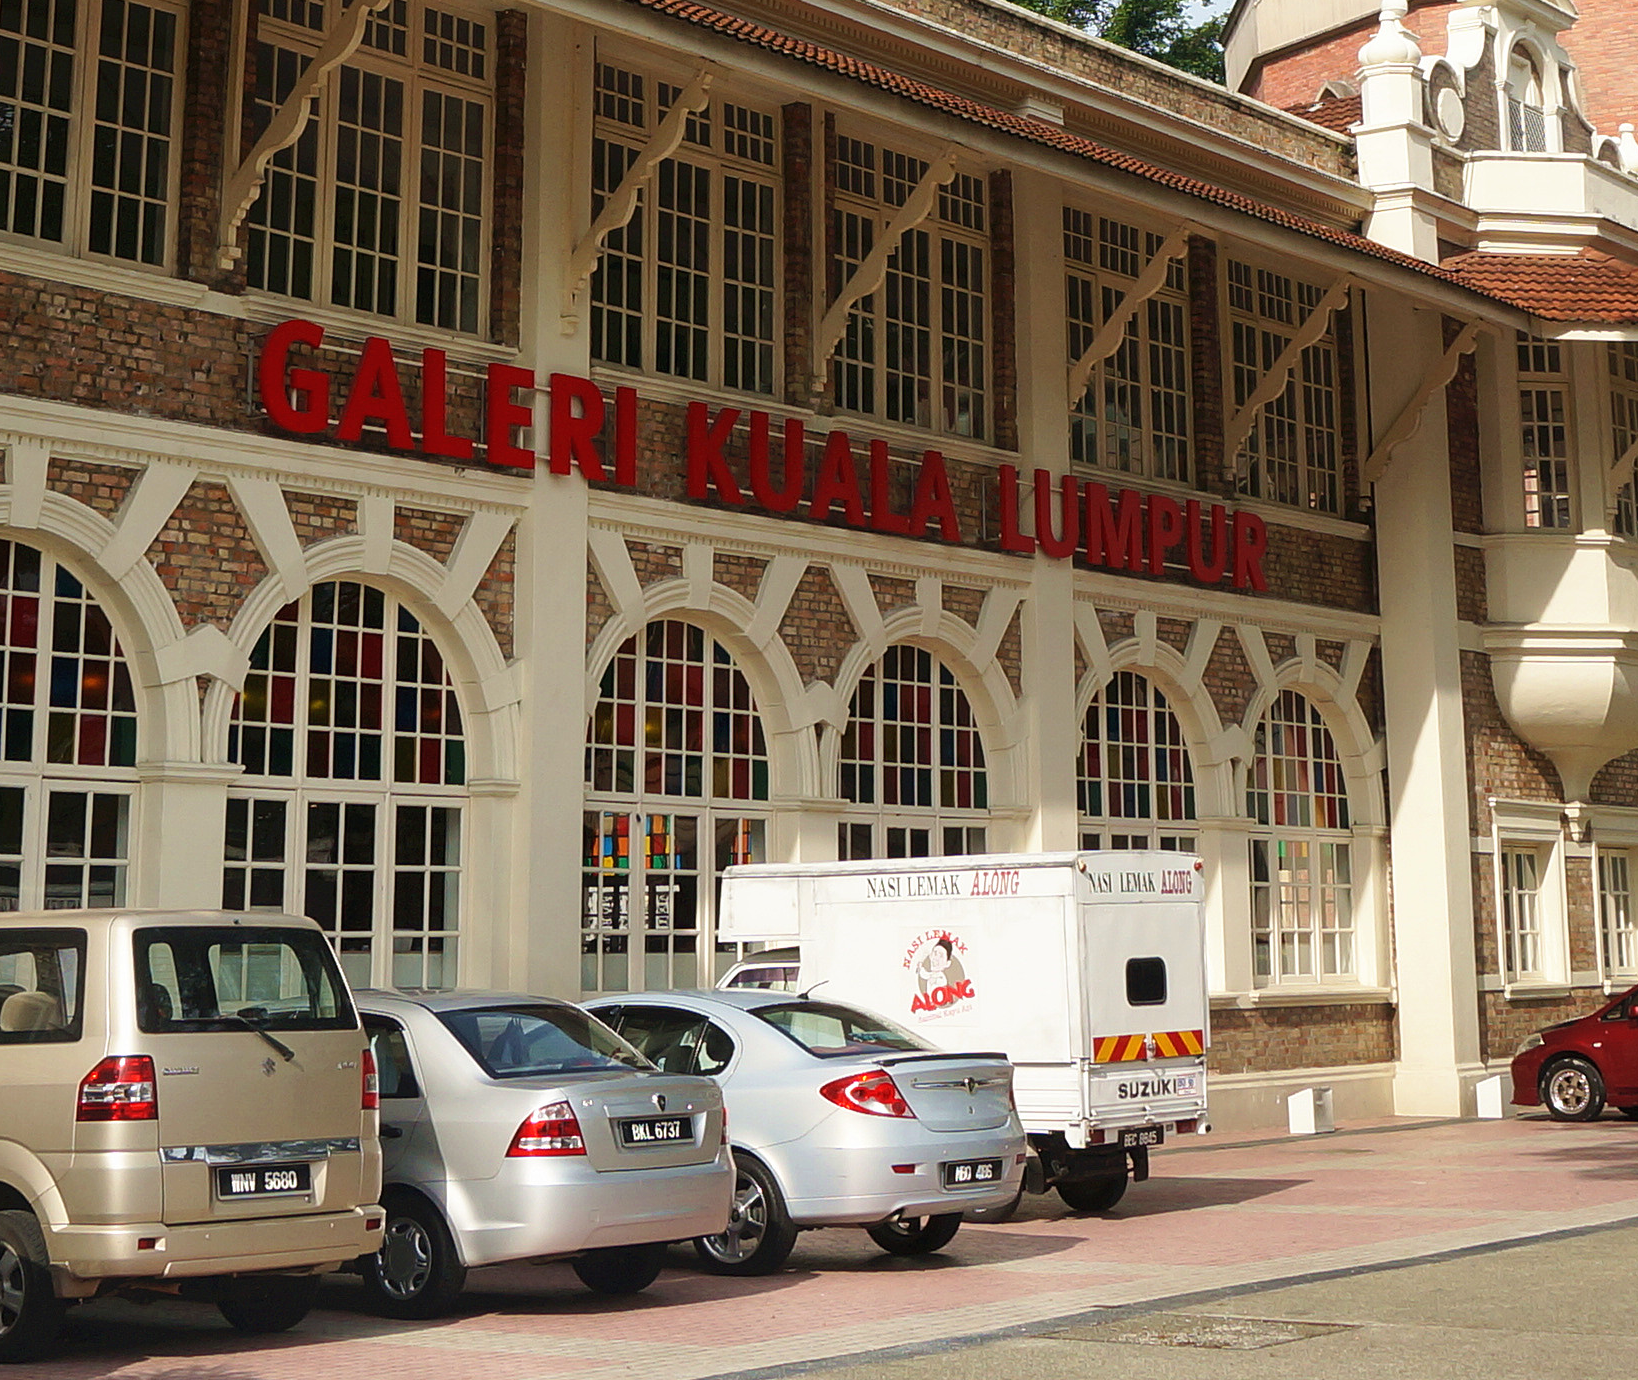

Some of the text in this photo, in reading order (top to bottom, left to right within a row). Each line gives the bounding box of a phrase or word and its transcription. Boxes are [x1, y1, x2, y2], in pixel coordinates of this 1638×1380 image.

[259, 318, 1269, 593] GALERI KUALA LUMPUR
[867, 870, 1020, 898] NASI LEMAK ALONG
[1088, 869, 1192, 894] NASI LEMAK ALONG
[903, 929, 968, 970] NASI LEMAK
[910, 978, 975, 1014] ALONG
[1118, 1078, 1177, 1099] SUZUKI
[632, 1121, 681, 1141] BKL 6737
[264, 1170, 298, 1191] 5680
